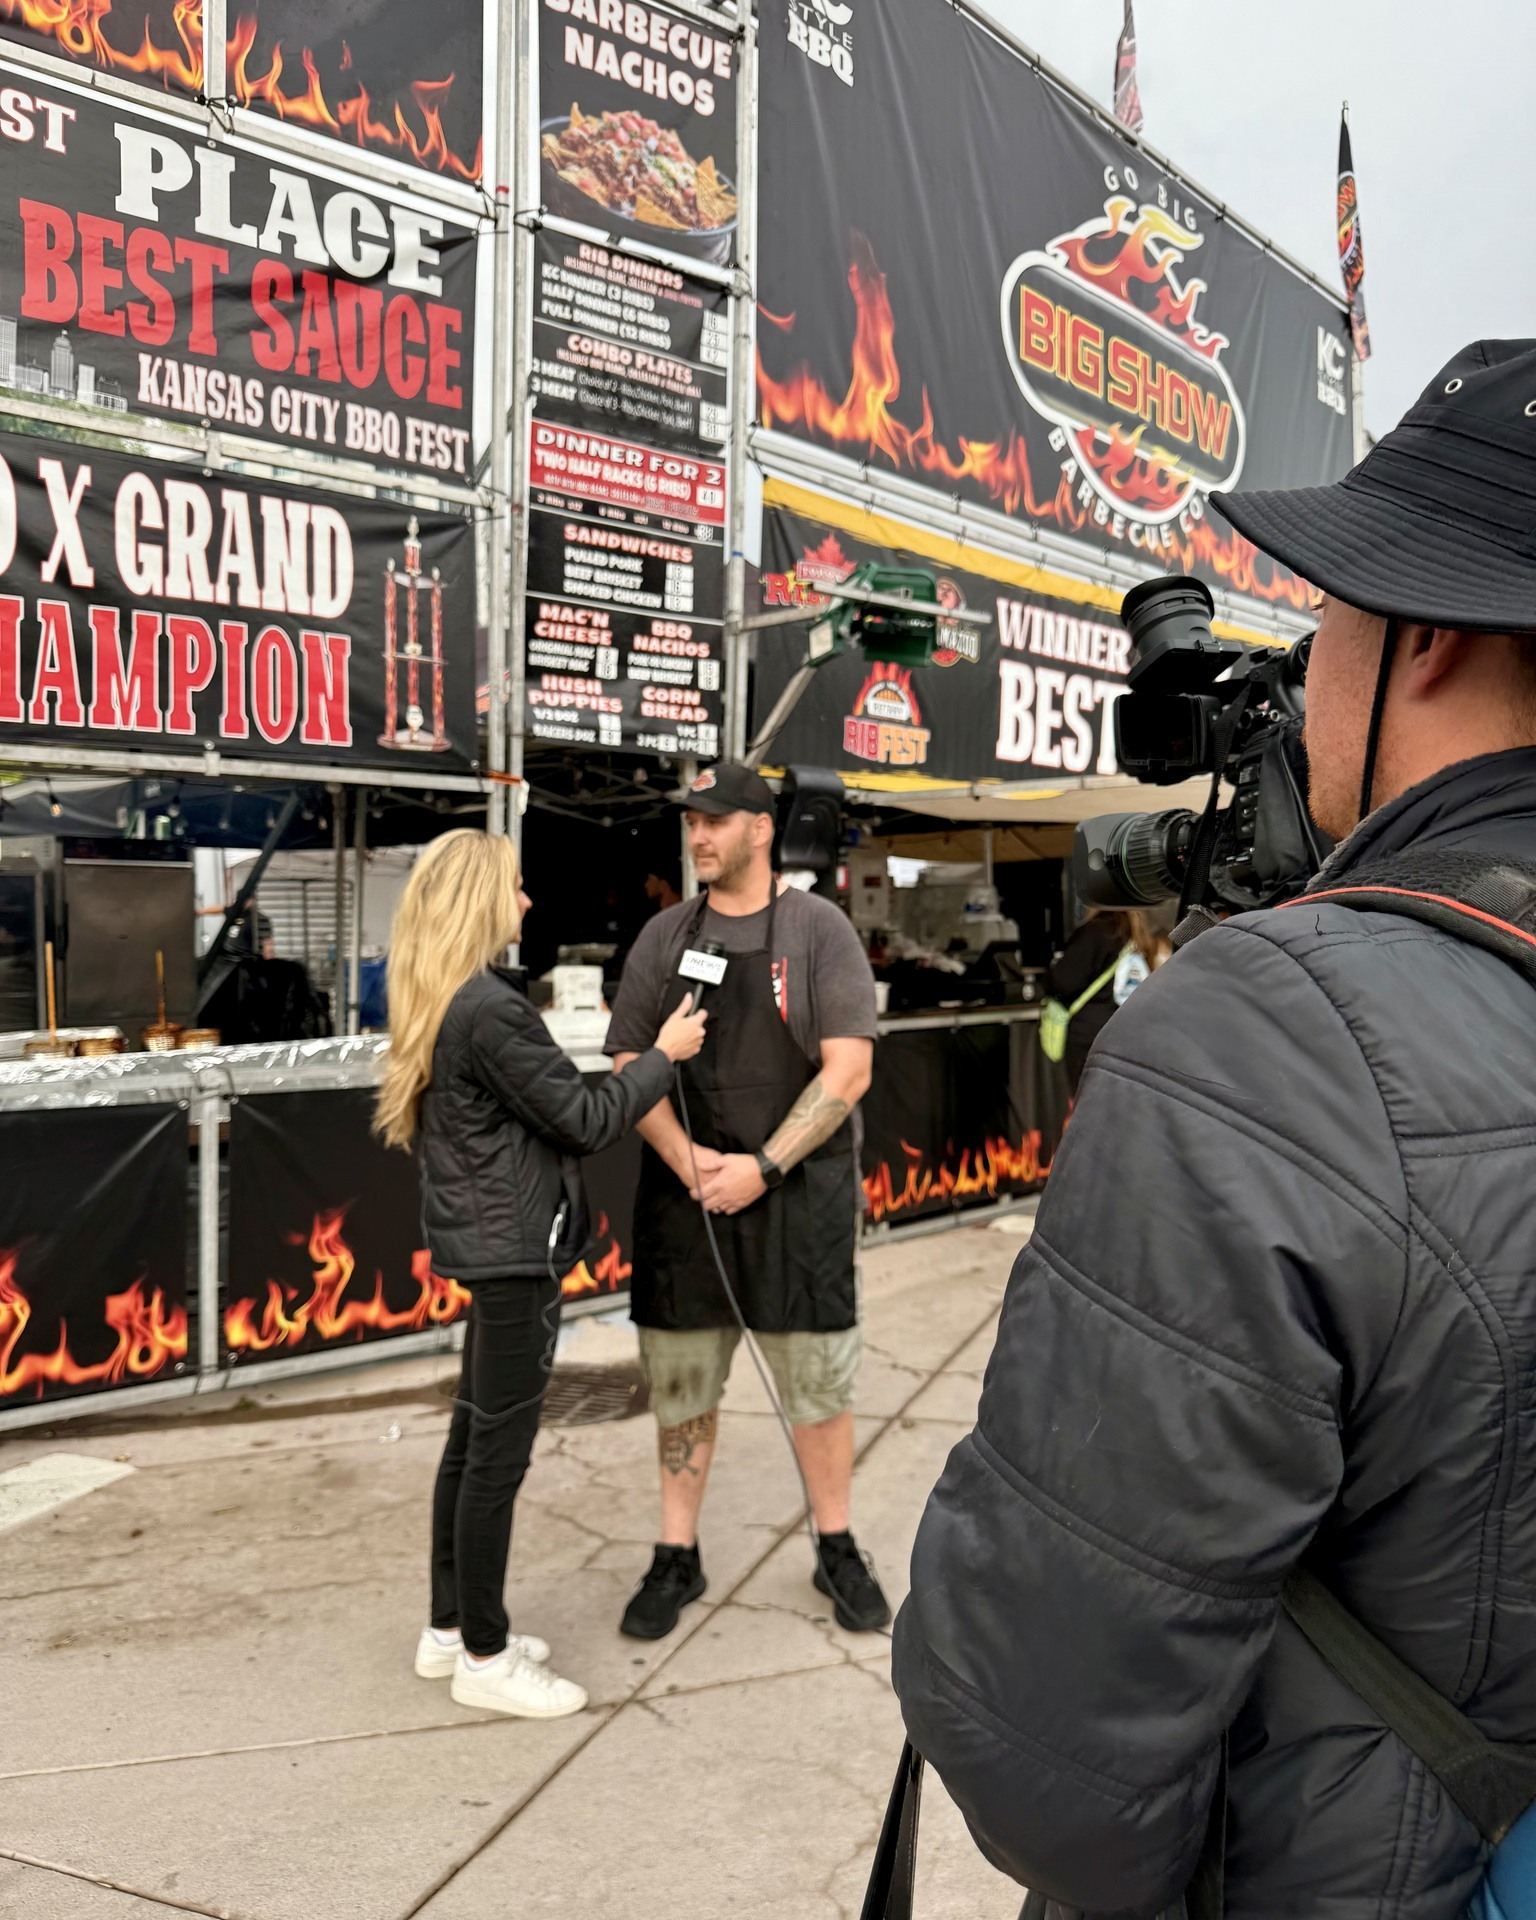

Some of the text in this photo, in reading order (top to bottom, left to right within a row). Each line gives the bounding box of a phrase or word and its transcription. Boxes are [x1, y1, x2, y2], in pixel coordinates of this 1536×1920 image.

[787, 9, 854, 88] BBQ
[564, 25, 715, 117] NACHOS
[114, 122, 444, 297] PLACE
[1104, 165, 1197, 230] GO BIG
[542, 263, 560, 280] KC
[561, 268, 607, 296] DINNER
[579, 243, 683, 290] RIB DINNERS
[19, 197, 462, 409] BEST SAUCE
[542, 280, 575, 301] HALF
[575, 290, 621, 316] DINNER
[542, 300, 573, 320] FULL
[573, 308, 619, 334] DINNER
[541, 362, 576, 381] MEAT
[567, 334, 693, 384] COMBO PLATES
[1318, 325, 1346, 381] KC
[541, 381, 577, 400] MEAT
[1107, 336, 1232, 462] SHOW
[138, 352, 469, 474] KANSAS CITY BBQ FEST
[535, 446, 566, 471] TWO
[567, 457, 601, 479] HALF
[602, 464, 644, 489] RACKS
[536, 427, 721, 486] DINNER FOR 2
[1047, 426, 1172, 549] BARBECUE
[38, 457, 95, 588] X
[114, 471, 355, 619] GRAND
[564, 523, 693, 563] SANDWICHES
[564, 562, 643, 590] BEEF BRISKET
[565, 545, 643, 573] PULLED PORK
[563, 579, 613, 600] SMOKED
[613, 586, 662, 608] CHICKEN
[534, 621, 612, 647] CHEESE
[633, 634, 710, 659] NACHOS
[652, 620, 692, 641] BBQ
[997, 597, 1132, 675] WINNER
[528, 689, 623, 713] PUPPIES
[542, 674, 602, 695] HUSH
[642, 686, 700, 706] CORN
[641, 702, 708, 722] BREAD
[996, 659, 1134, 776] BEST
